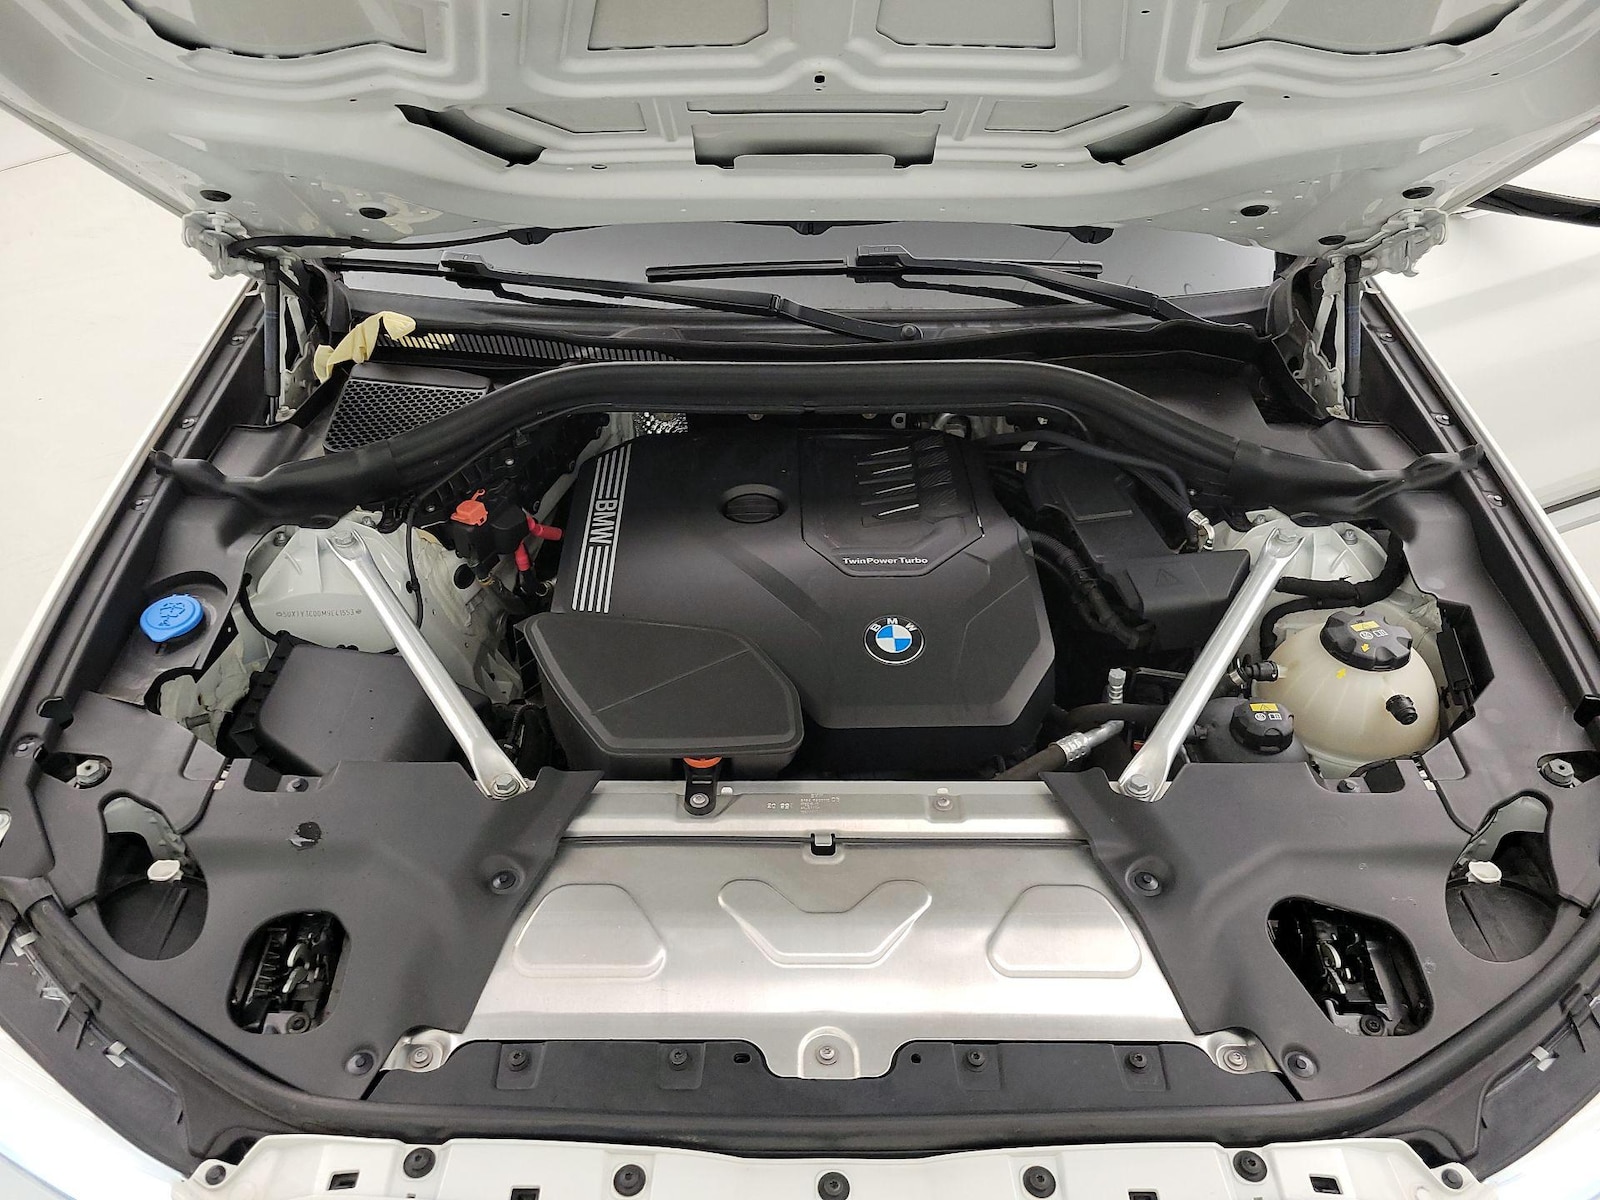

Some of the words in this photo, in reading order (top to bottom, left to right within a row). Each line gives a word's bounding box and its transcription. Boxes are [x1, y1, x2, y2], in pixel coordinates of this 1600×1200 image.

[589, 499, 618, 544] BMW
[842, 557, 897, 565] TwinPower
[898, 556, 929, 565] Turbo
[869, 617, 918, 632] BMW
